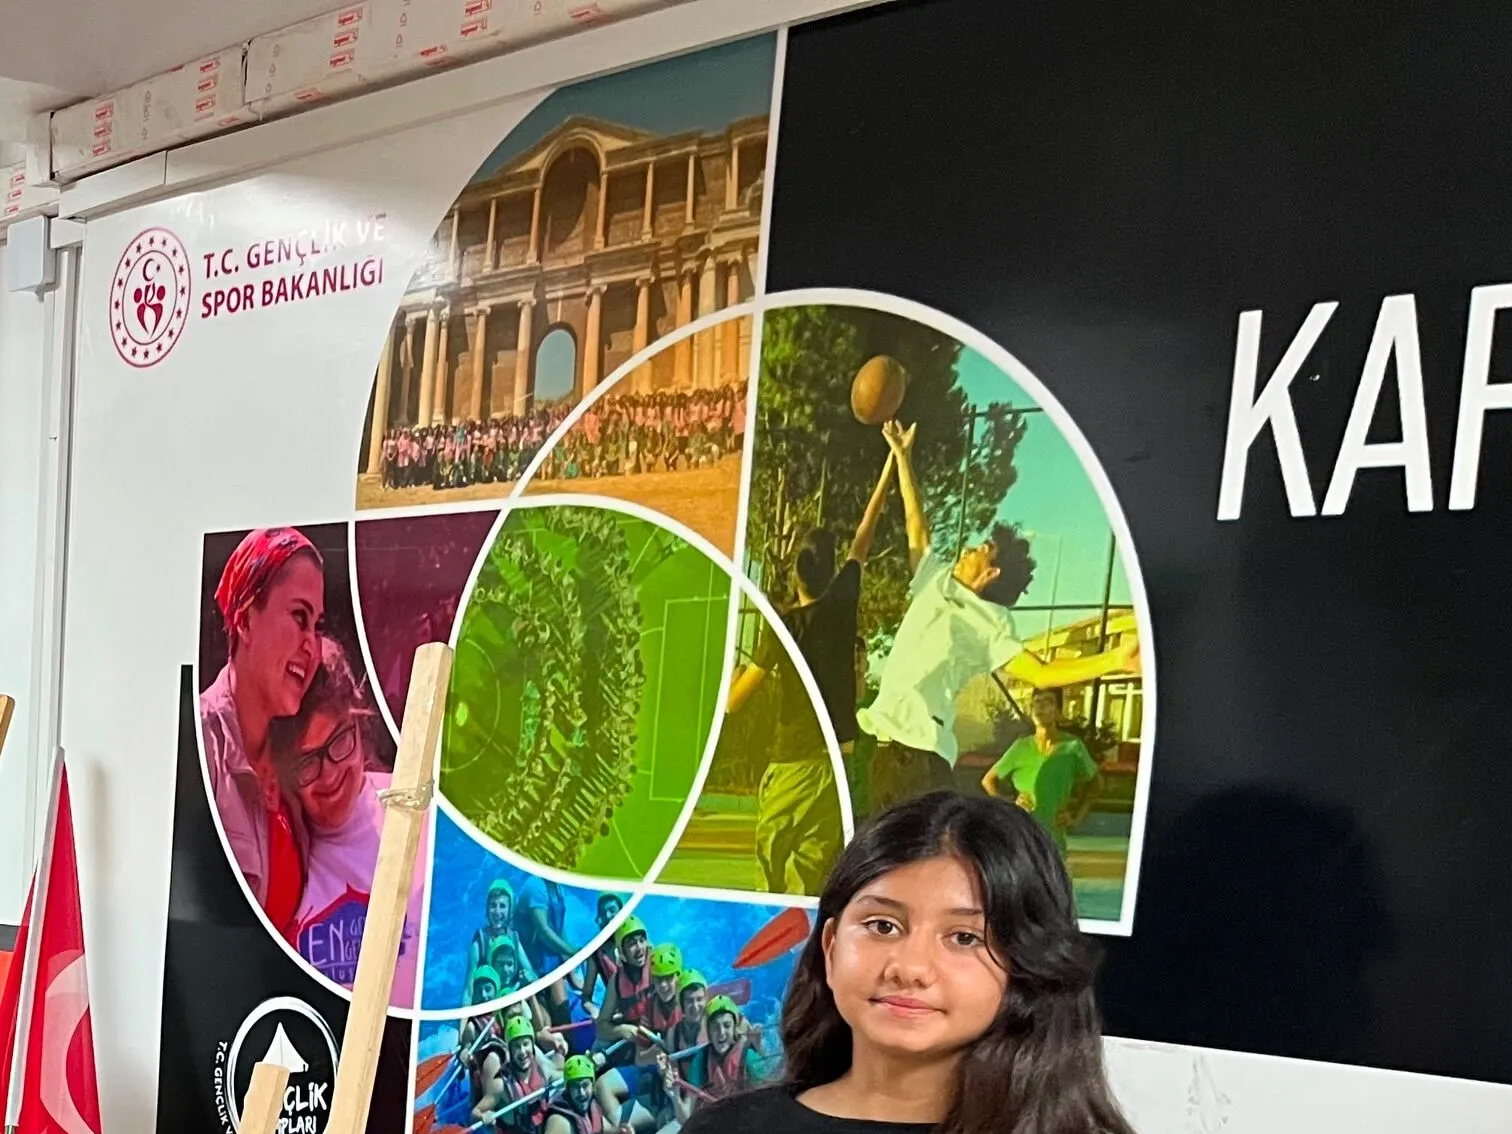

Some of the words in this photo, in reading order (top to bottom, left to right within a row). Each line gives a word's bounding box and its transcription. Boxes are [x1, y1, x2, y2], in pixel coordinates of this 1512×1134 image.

[201, 284, 255, 319] SPOR
[261, 254, 384, 306] BAKANLIĞI
[203, 248, 239, 279] T.C.
